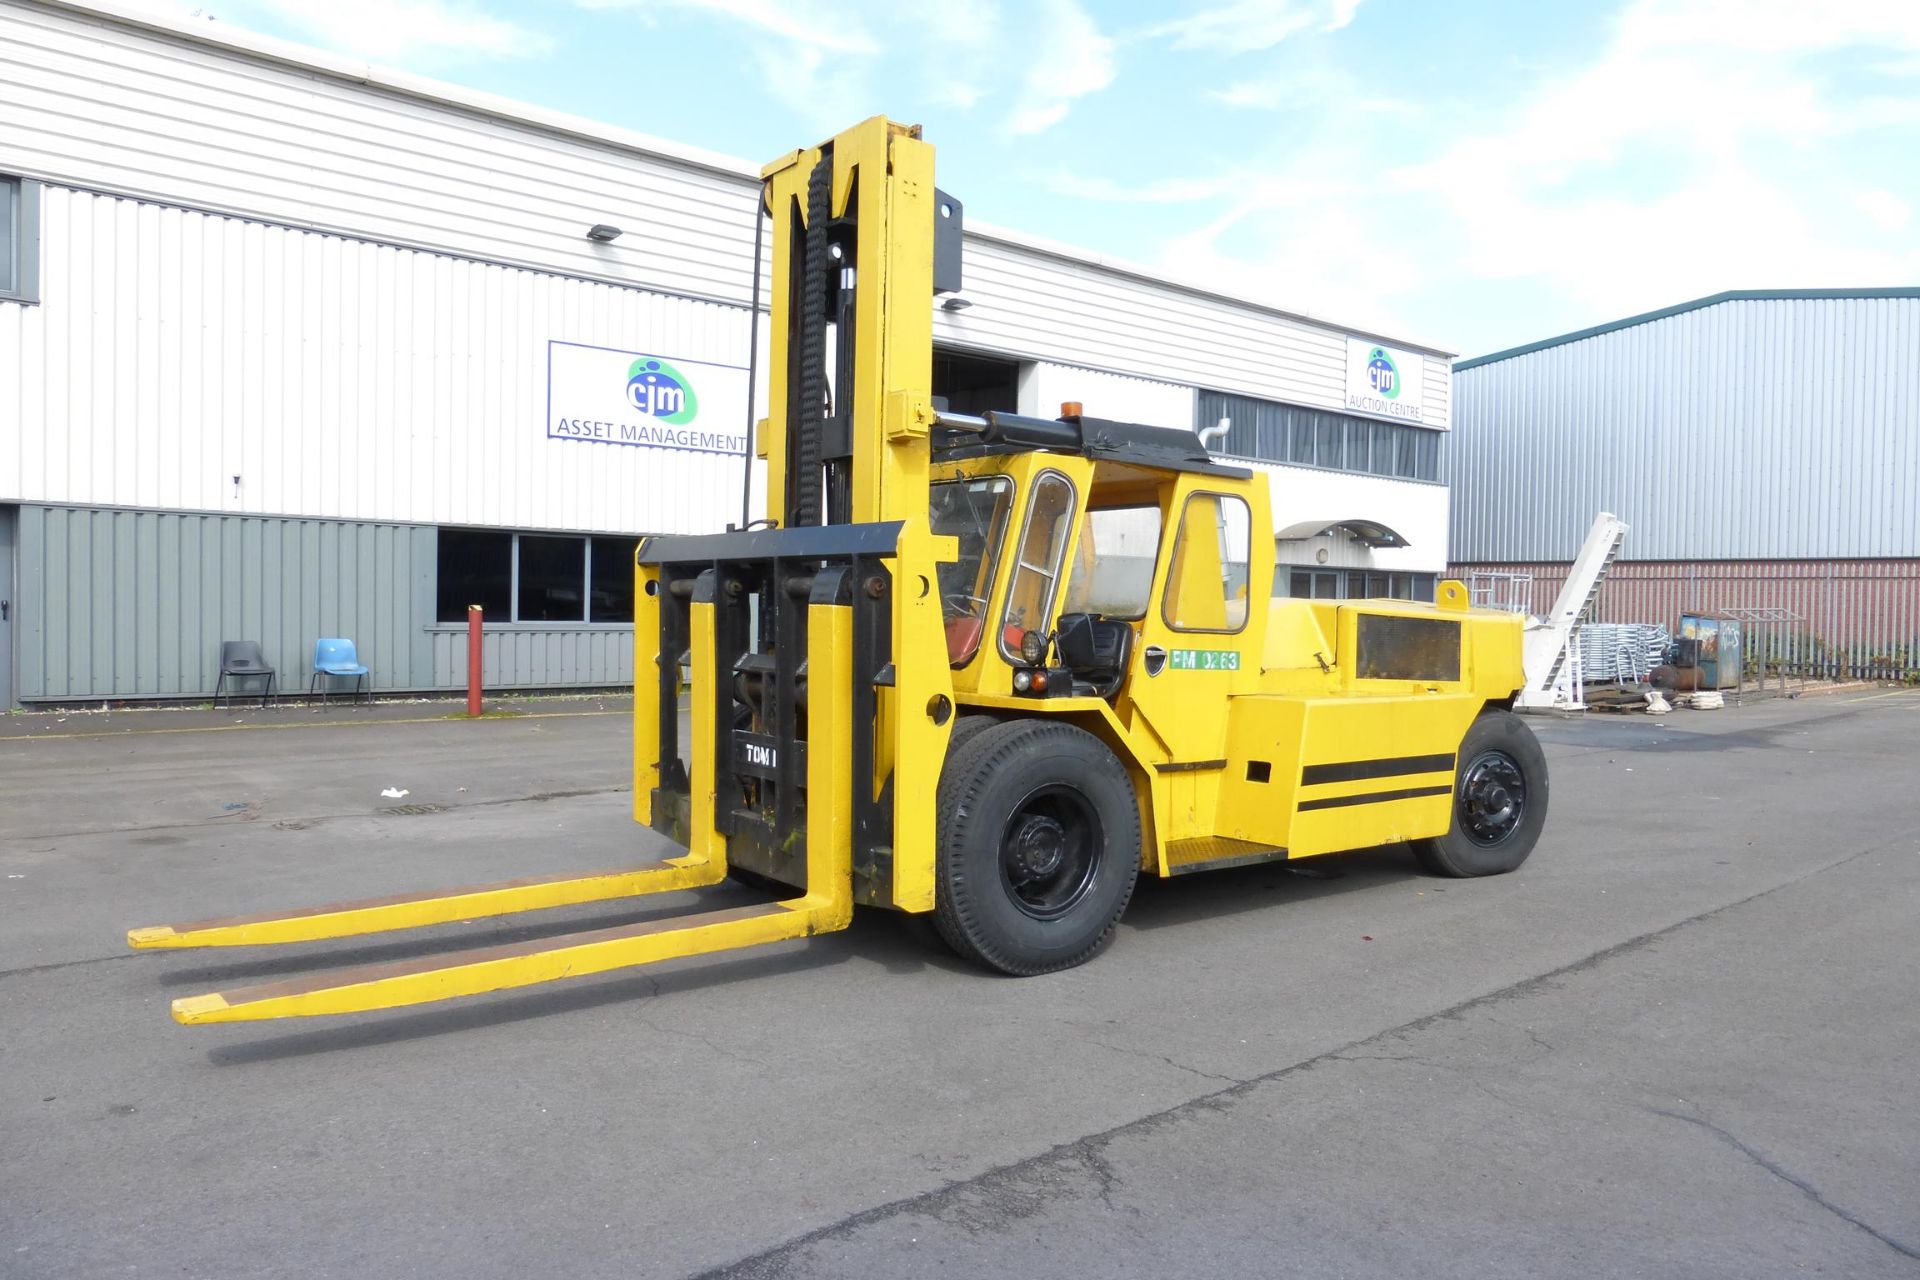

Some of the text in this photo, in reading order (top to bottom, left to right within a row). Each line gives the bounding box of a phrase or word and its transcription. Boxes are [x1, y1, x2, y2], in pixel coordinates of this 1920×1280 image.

[1368, 361, 1394, 392] cjm
[628, 375, 685, 416] cjm
[1350, 395, 1420, 419] AUCTION CENTRE
[557, 418, 747, 451] ASSET MANAGEMENT
[746, 743, 769, 765] TOM
